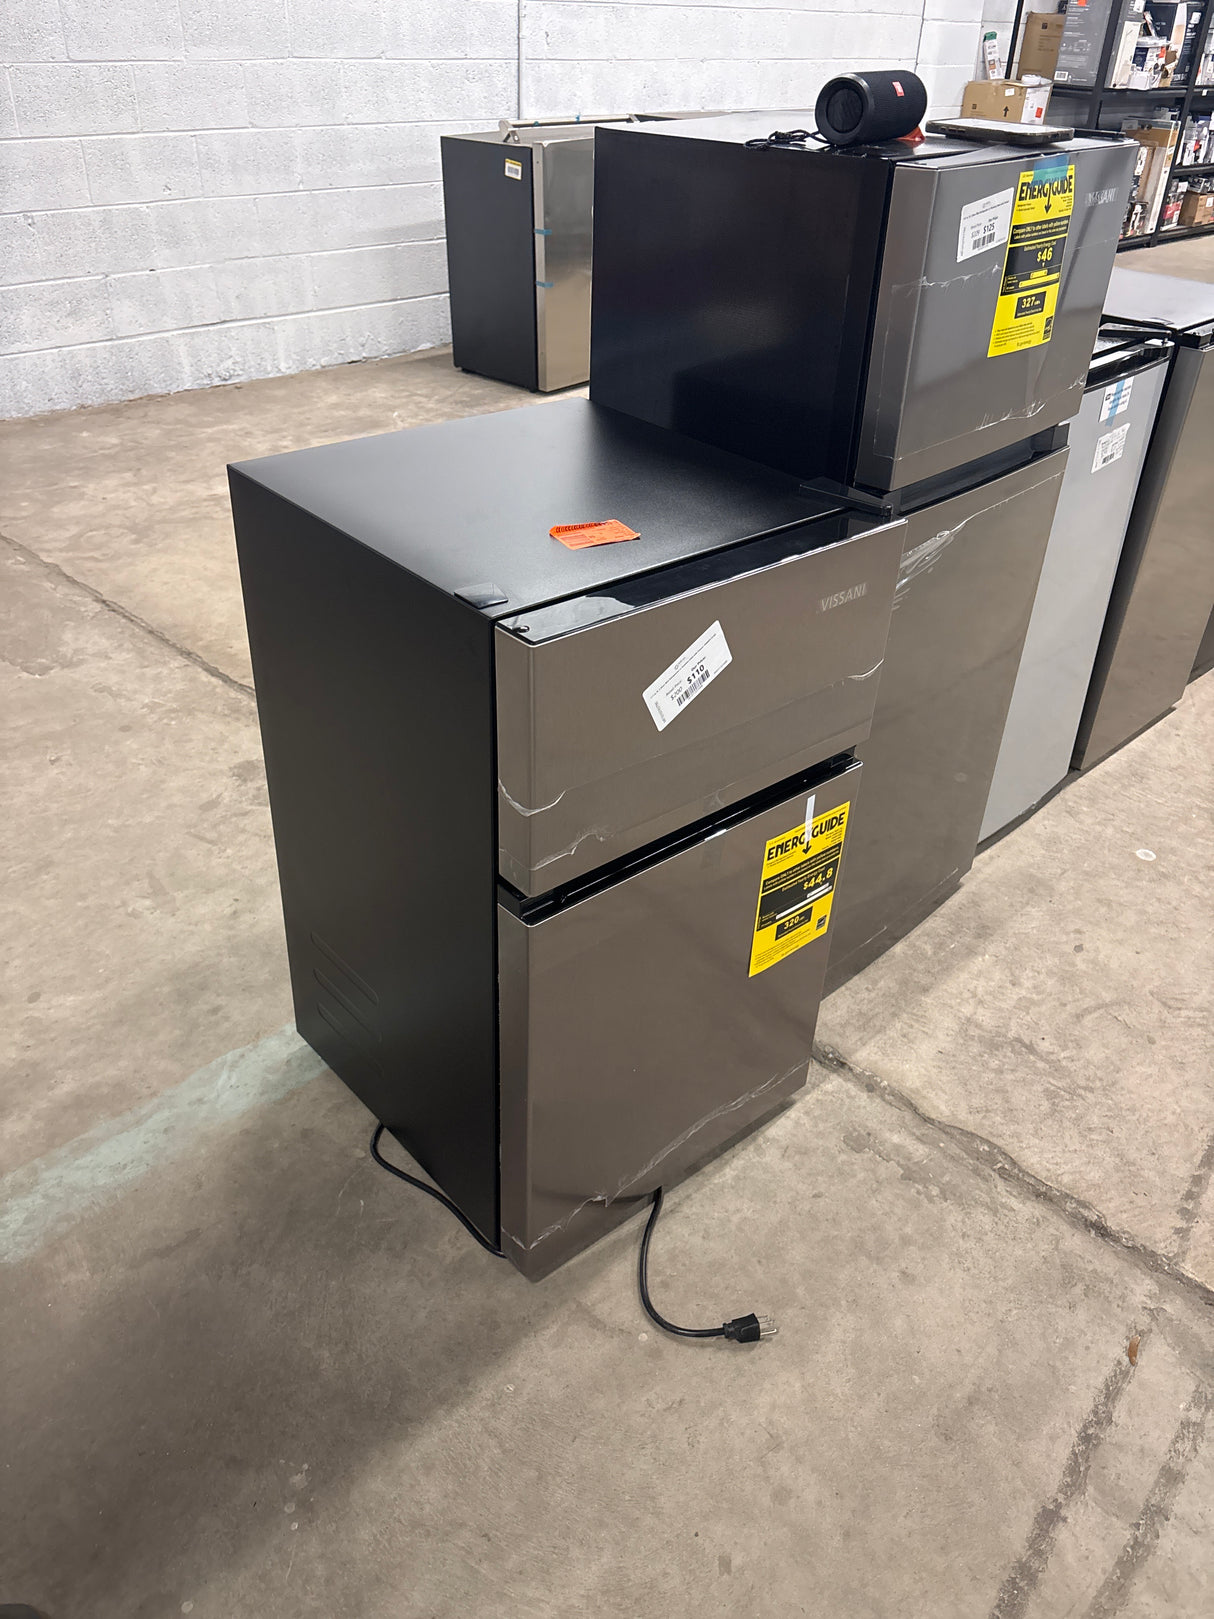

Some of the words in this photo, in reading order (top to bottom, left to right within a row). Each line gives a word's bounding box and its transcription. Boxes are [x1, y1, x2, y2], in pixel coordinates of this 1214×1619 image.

[983, 223, 995, 233] $125
[1037, 247, 1052, 262] $46
[1022, 296, 1035, 308] 327
[821, 583, 866, 611] VISSANI
[686, 664, 706, 685] $110
[803, 868, 833, 890] $44.8
[784, 916, 799, 930] 320
